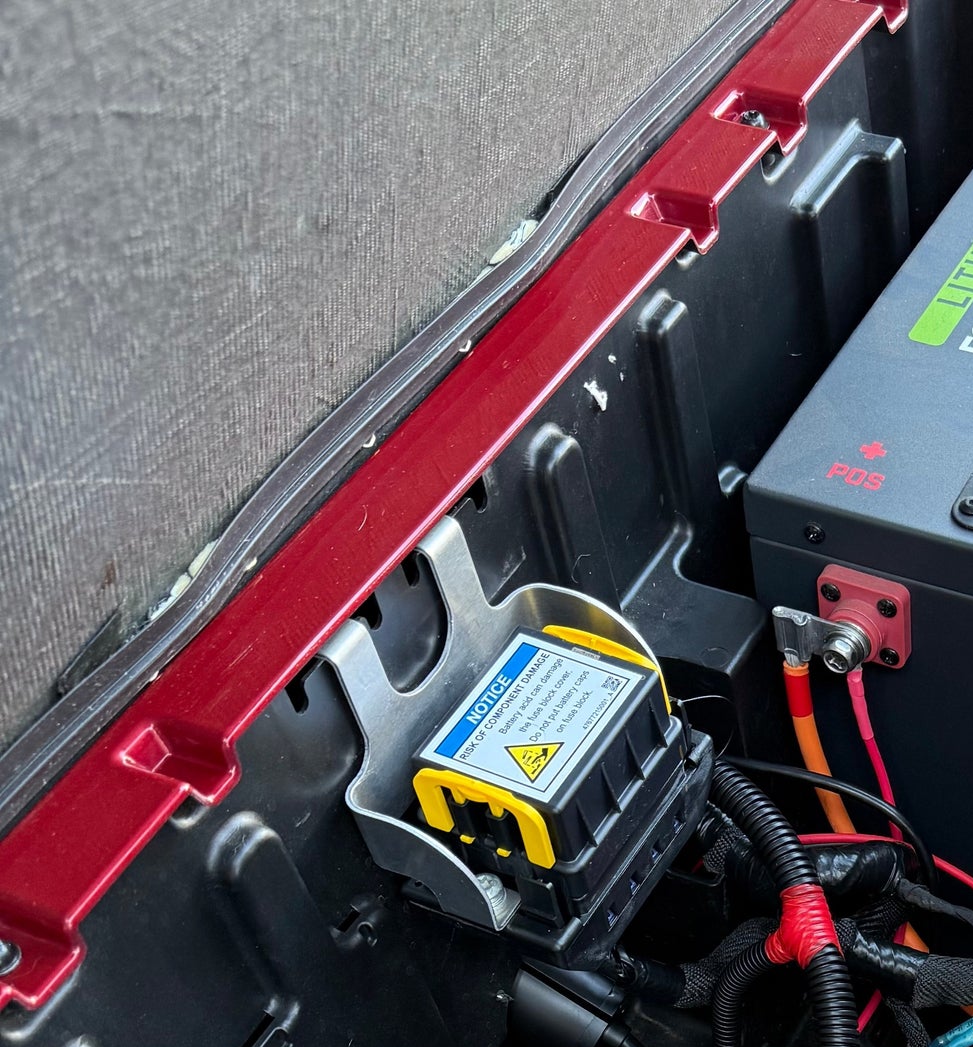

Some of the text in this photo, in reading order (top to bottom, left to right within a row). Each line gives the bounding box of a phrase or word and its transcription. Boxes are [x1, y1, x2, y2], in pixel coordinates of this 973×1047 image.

[826, 462, 886, 491] POS
[458, 652, 551, 760] RISK OF COMPONENT DAMAGE
[466, 673, 513, 724] NOTICE
[498, 658, 565, 734] Battery acid can damage
[518, 669, 573, 732] the fuse block cover.
[528, 730, 542, 742] Do
[538, 720, 551, 731] not
[546, 708, 562, 720] put
[554, 686, 579, 709] battery
[573, 670, 591, 686] caps
[555, 723, 567, 733] on
[561, 708, 578, 723] fuse
